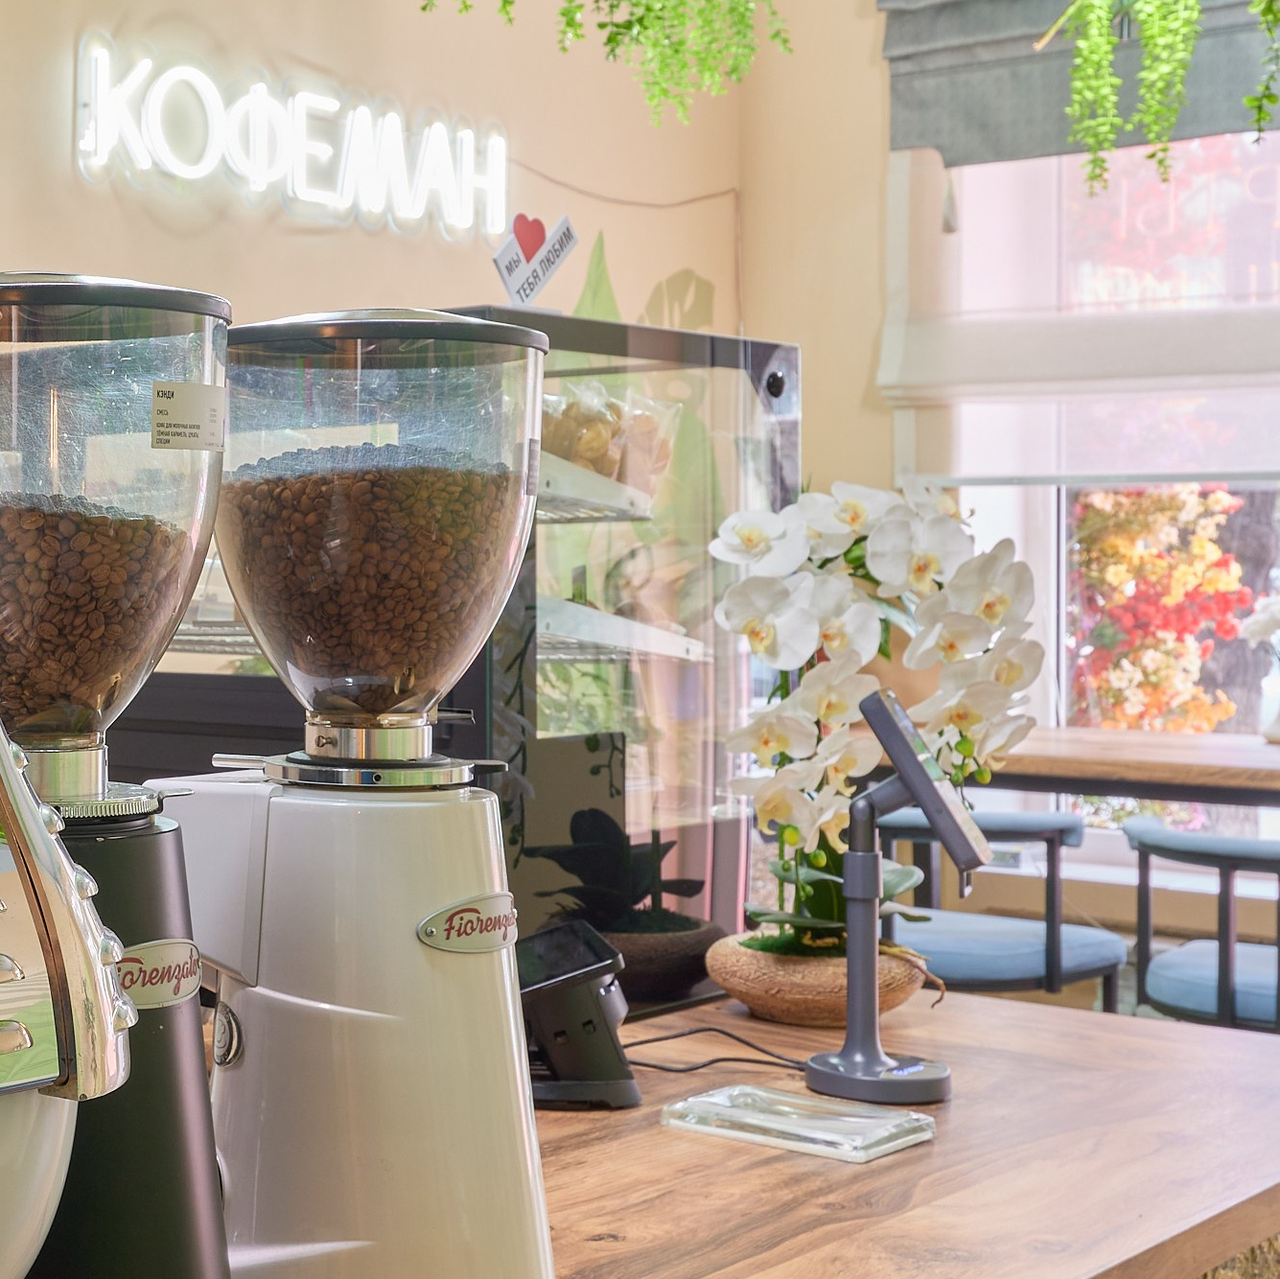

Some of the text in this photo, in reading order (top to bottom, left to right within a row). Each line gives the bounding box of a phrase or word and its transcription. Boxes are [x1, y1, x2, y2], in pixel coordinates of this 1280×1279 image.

[80, 47, 506, 234] КОФЕМАН
[505, 252, 523, 276] МЫ
[516, 226, 574, 303] ТЕБЯ ЛЮБИМ
